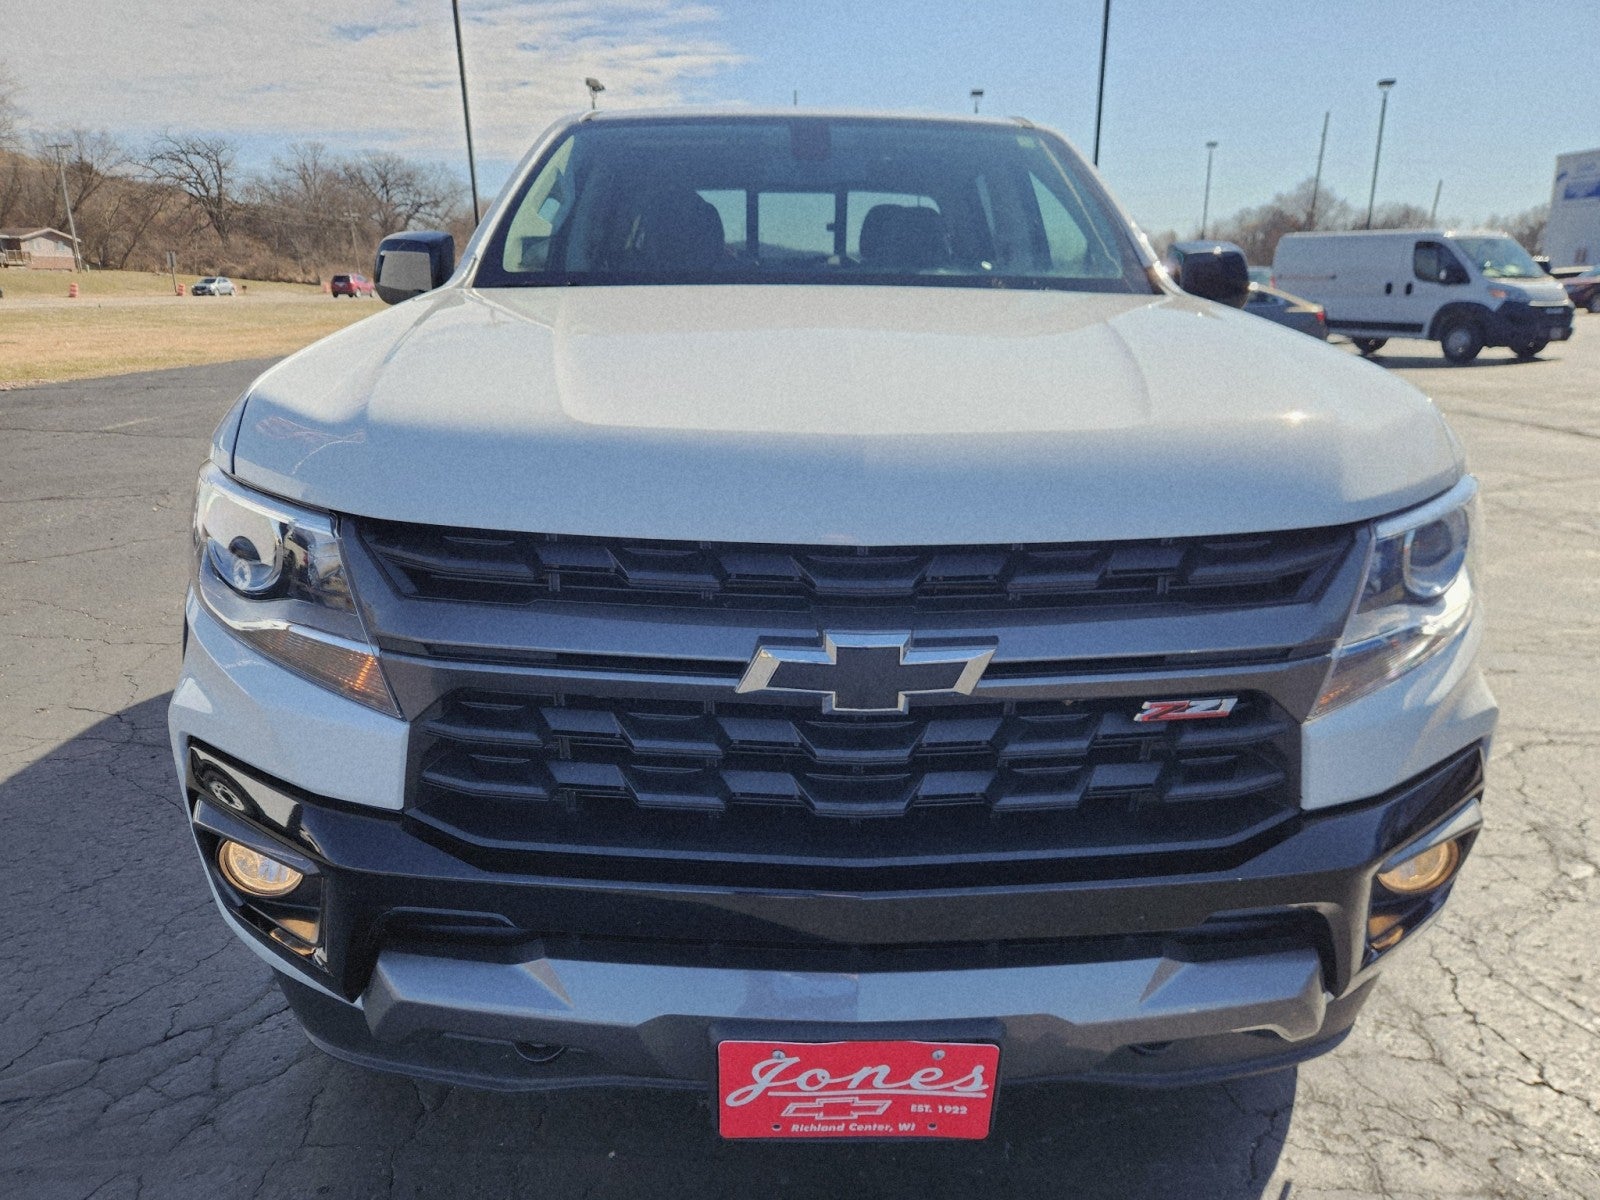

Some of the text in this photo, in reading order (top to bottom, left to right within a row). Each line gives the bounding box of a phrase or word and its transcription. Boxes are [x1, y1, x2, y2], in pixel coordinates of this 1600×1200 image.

[725, 1056, 989, 1107] Jones
[910, 1104, 968, 1114] EST. 1922
[791, 1123, 916, 1132] Richland Center, WI
